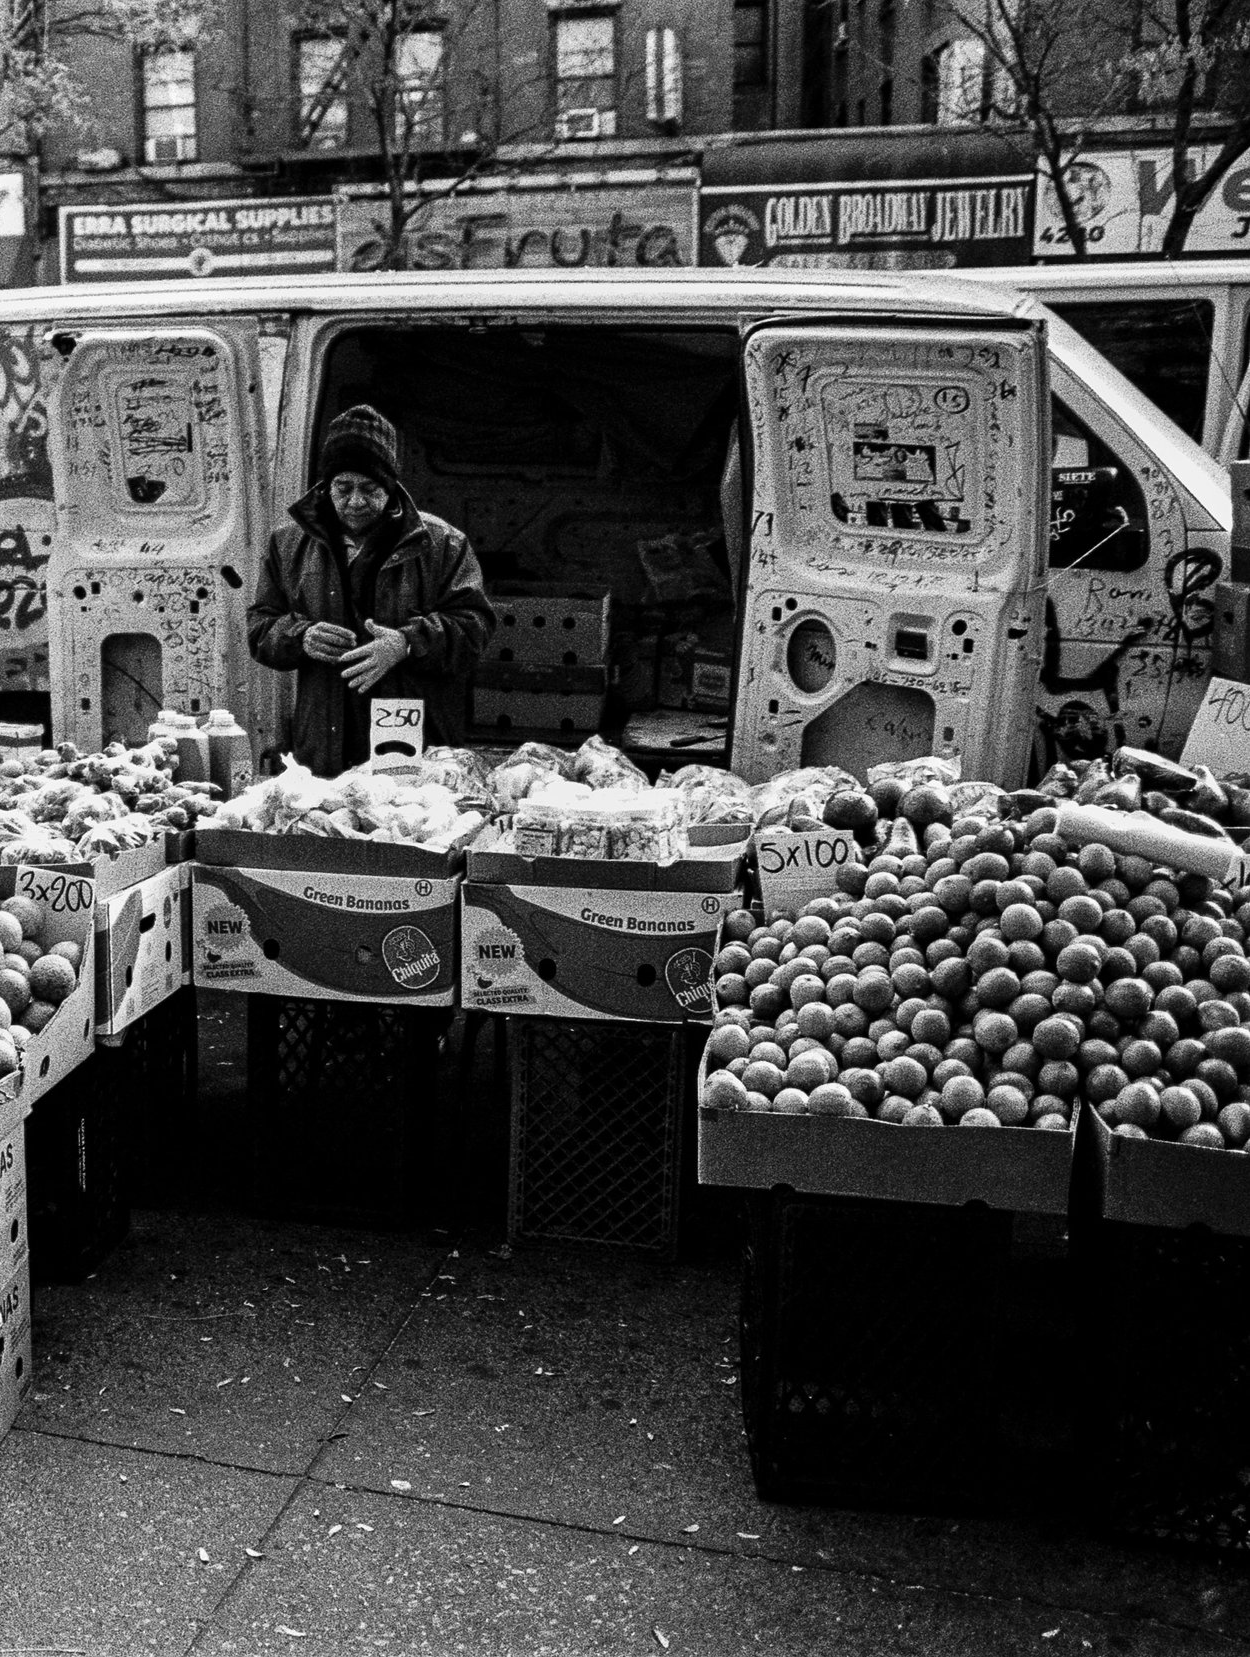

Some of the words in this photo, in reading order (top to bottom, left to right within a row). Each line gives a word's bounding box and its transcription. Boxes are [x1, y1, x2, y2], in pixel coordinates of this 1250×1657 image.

[130, 211, 232, 235] SURGICAL
[235, 204, 335, 229] SUPPLIES
[765, 195, 832, 247] GOLDEN
[837, 192, 930, 245] BROADWAY
[931, 186, 1029, 242] JEWELRY
[1040, 226, 1105, 244] 420
[376, 708, 421, 727] 250
[760, 838, 849, 873] 5x100
[19, 871, 93, 912] 3x200
[304, 886, 343, 908] Green
[346, 896, 411, 911] Bananas
[207, 920, 242, 934] NEW
[581, 908, 623, 929] Green
[627, 917, 695, 932] Bananas
[478, 945, 516, 959] NEW
[207, 970, 230, 979] CLASS
[230, 969, 255, 977] EXTRA
[391, 952, 441, 984] Chiquita
[477, 997, 501, 1006] CLASS
[502, 996, 529, 1004] EXTRA
